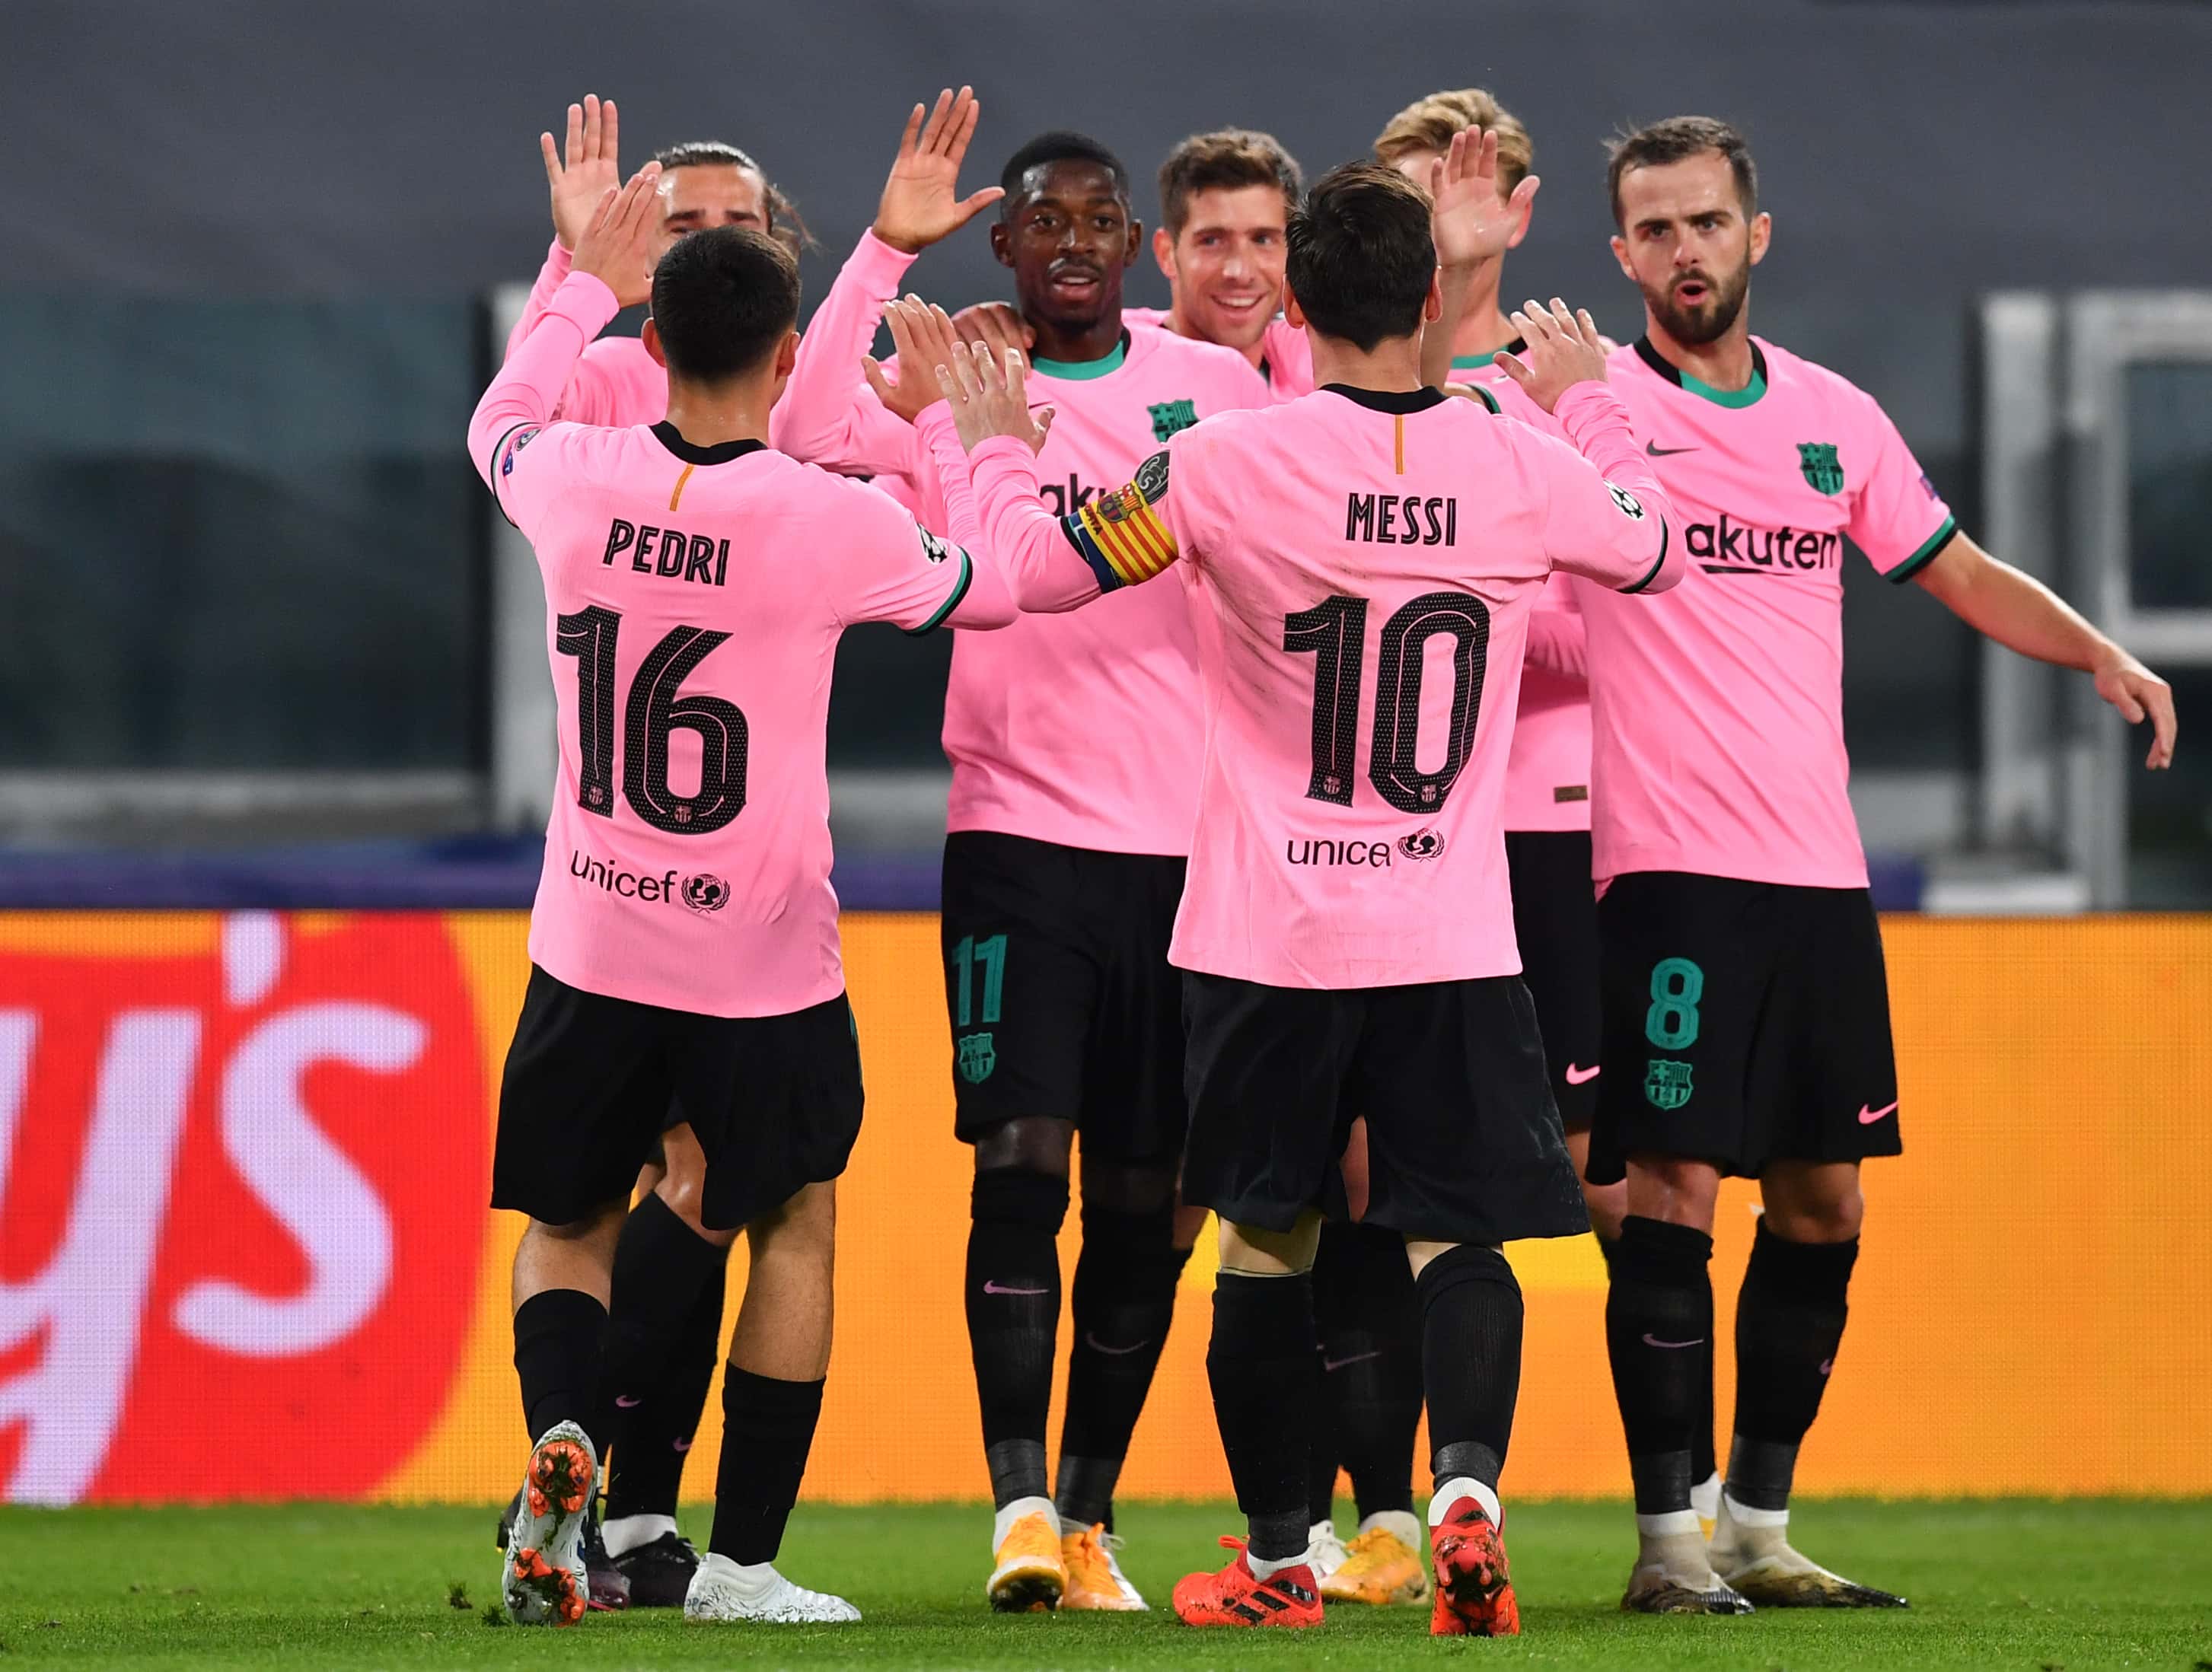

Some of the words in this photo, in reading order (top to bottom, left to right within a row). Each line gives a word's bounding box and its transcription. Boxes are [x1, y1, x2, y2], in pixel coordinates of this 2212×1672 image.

[602, 518, 731, 587] PEDRI
[1345, 492, 1457, 546] MESSI
[1684, 514, 1837, 569] akuten
[556, 604, 749, 835] 16
[1283, 591, 1490, 814] 10
[571, 850, 677, 903] unicef
[951, 935, 1008, 1027] 11
[1645, 957, 1704, 1050] 8
